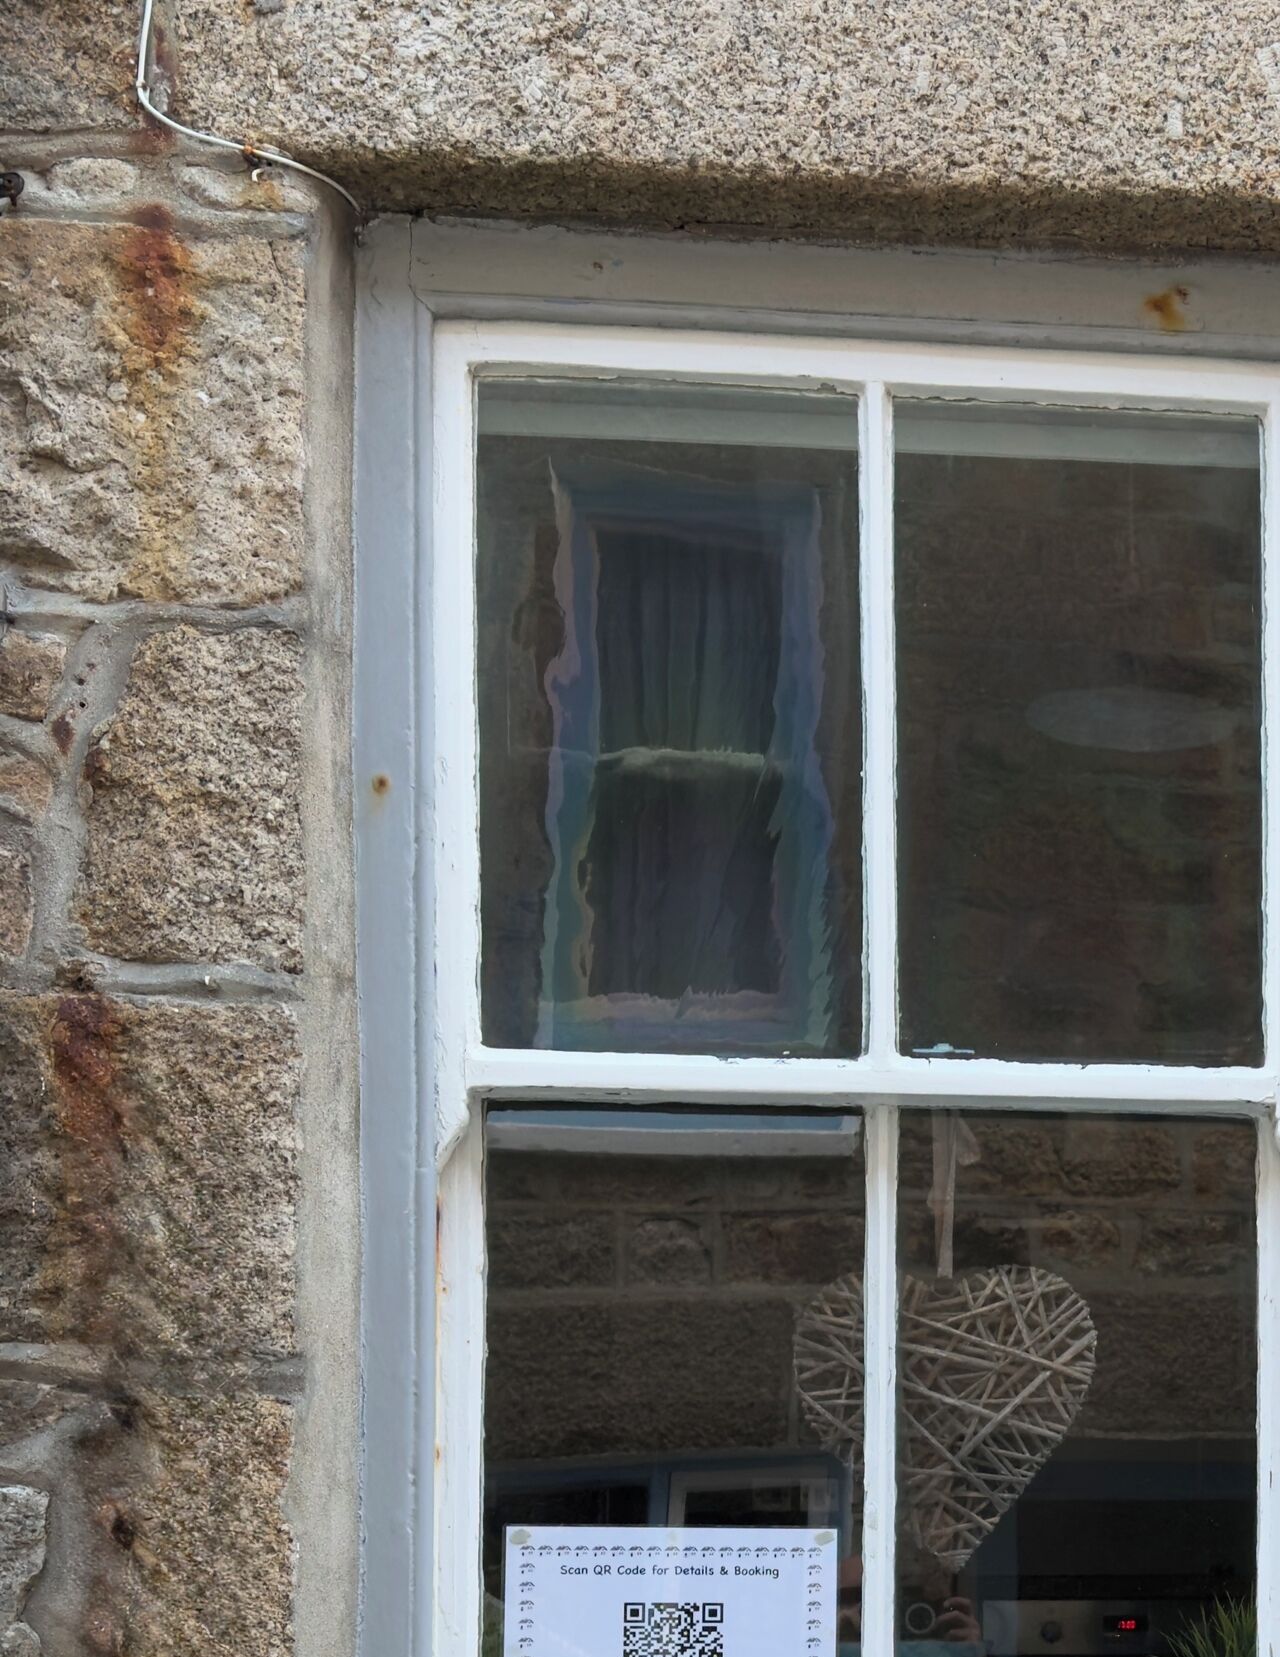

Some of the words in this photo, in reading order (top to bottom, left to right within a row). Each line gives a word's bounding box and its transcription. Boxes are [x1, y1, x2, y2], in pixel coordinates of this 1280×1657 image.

[560, 1565, 588, 1575] Scan
[593, 1564, 612, 1576] QR
[617, 1565, 646, 1575] Code
[652, 1565, 669, 1575] for
[674, 1565, 715, 1576] Details
[719, 1566, 728, 1575] &
[734, 1566, 779, 1579] Booking
